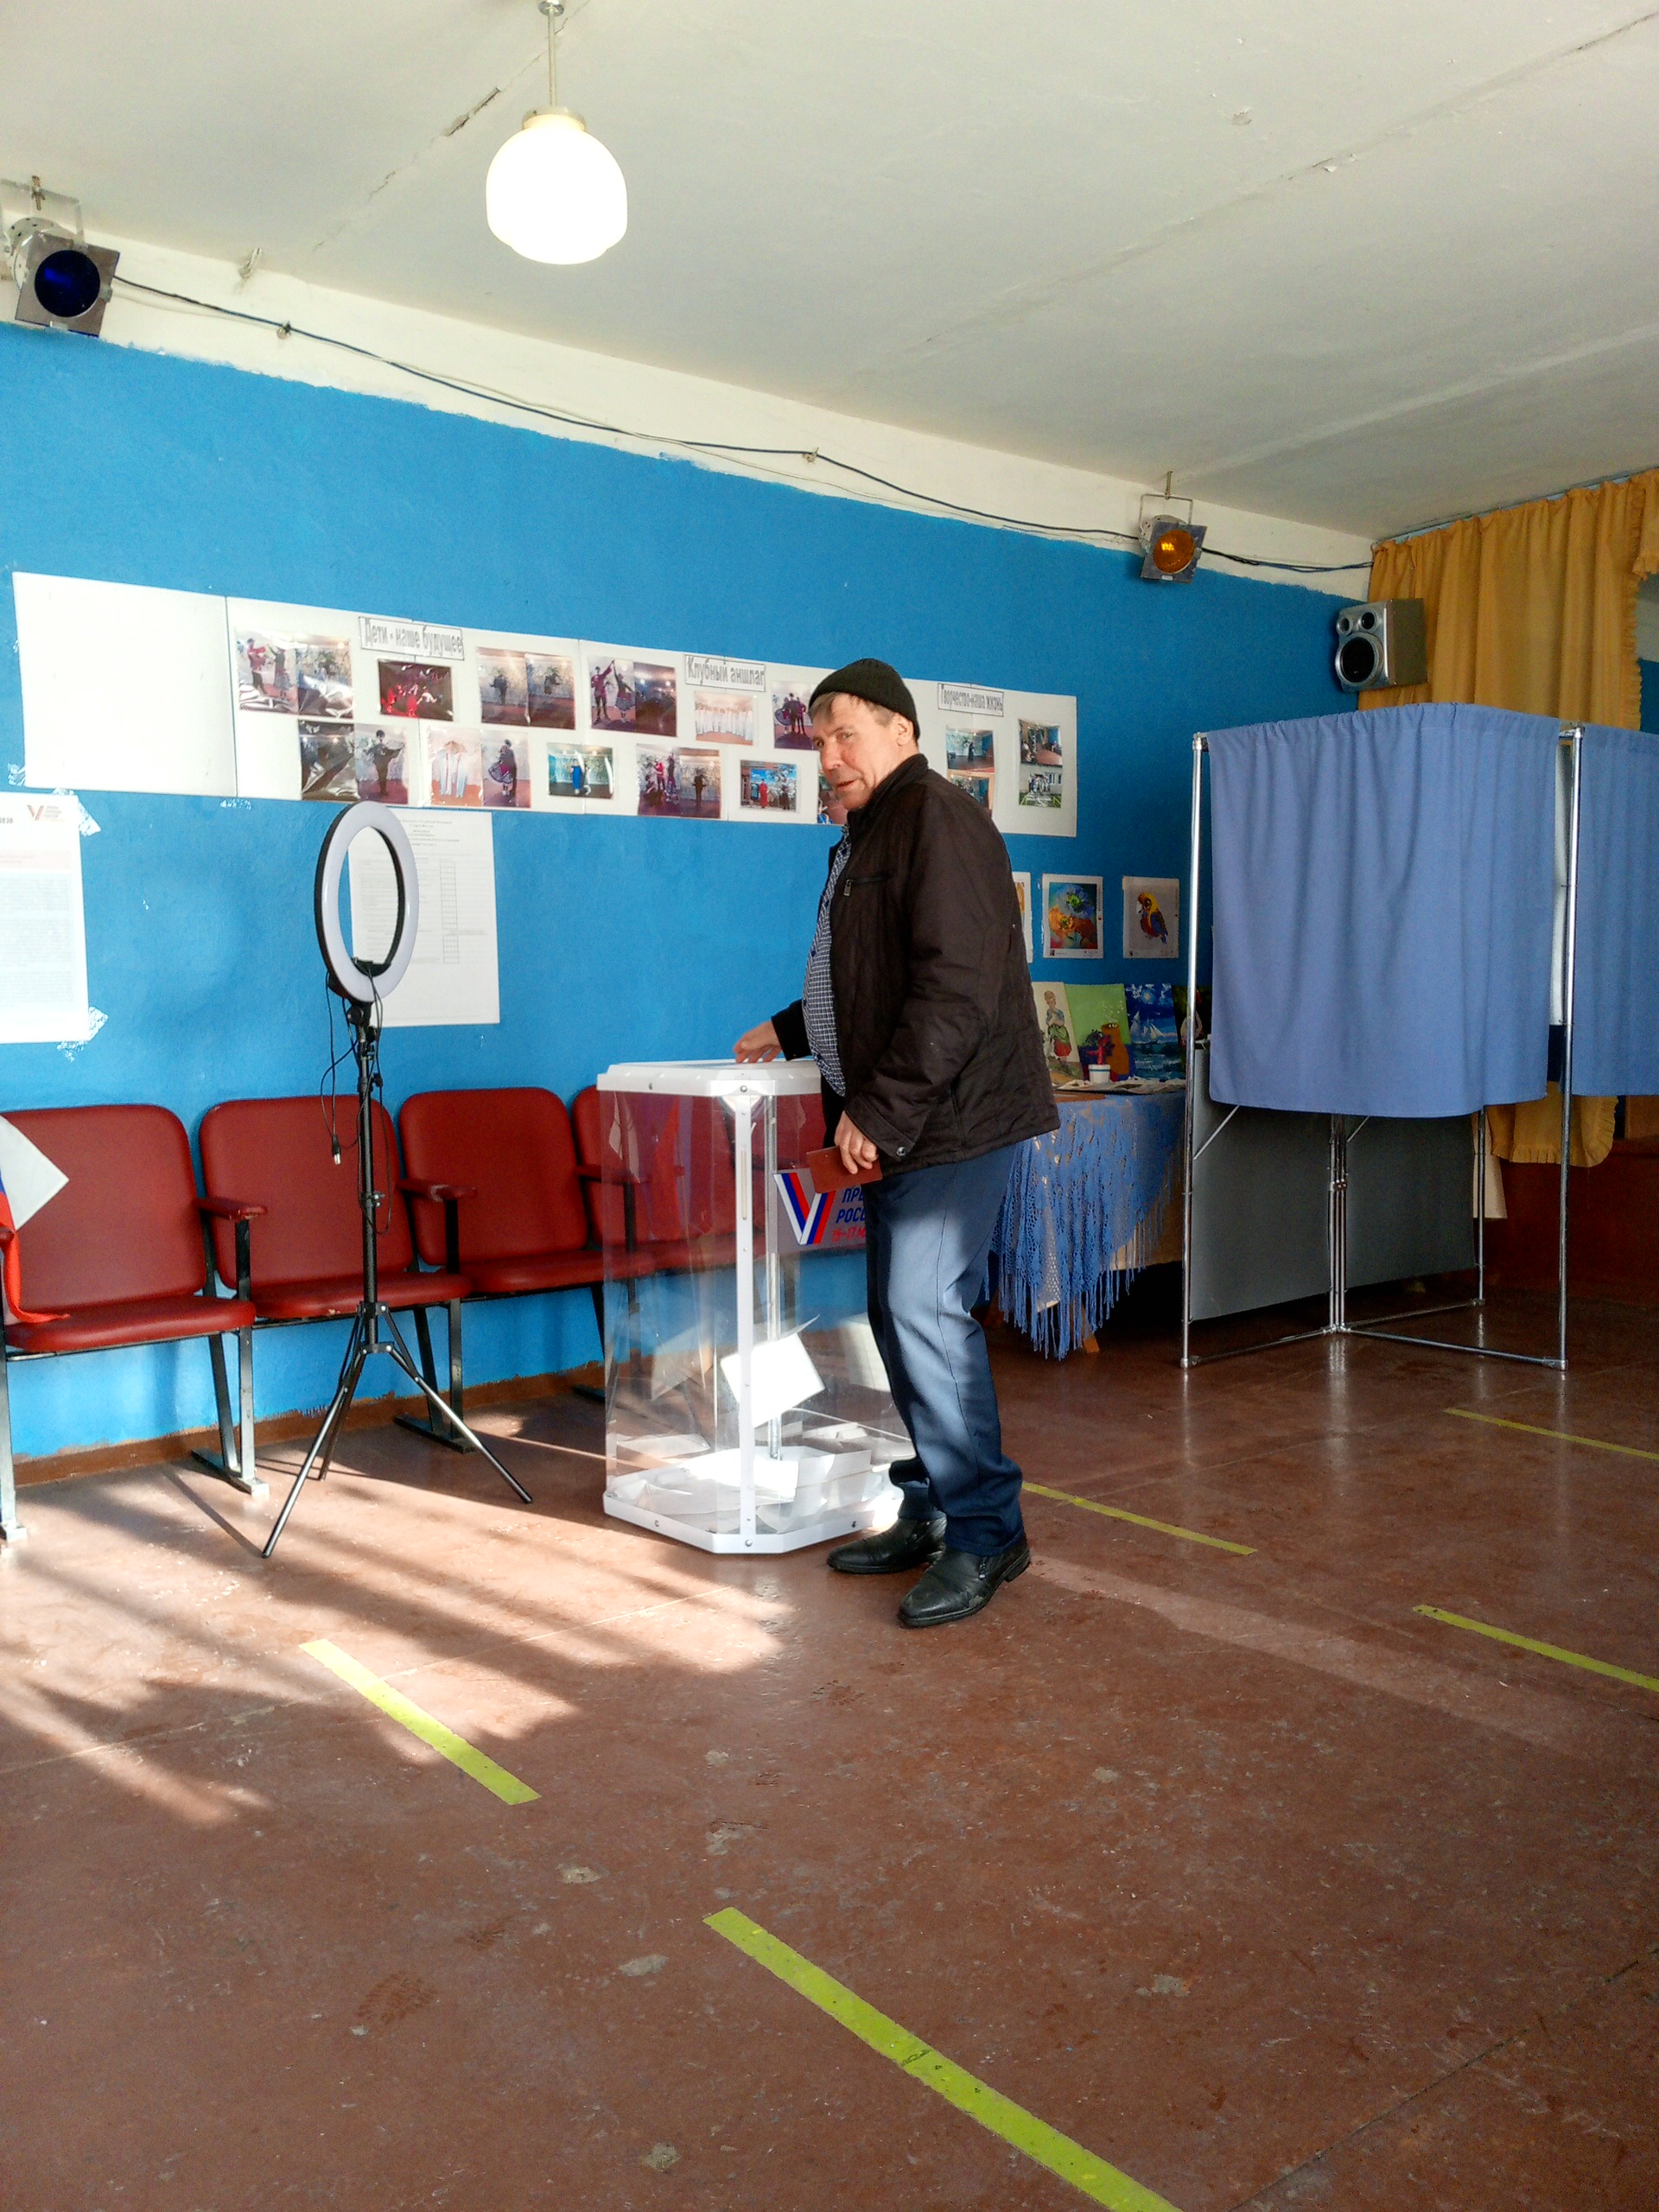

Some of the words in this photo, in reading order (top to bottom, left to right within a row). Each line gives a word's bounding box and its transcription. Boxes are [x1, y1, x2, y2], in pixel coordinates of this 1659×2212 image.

[365, 618, 388, 647] Дети
[395, 627, 421, 649] наше
[422, 625, 463, 657] будущее
[688, 657, 728, 685] Клубный
[730, 666, 765, 686] аншлаг
